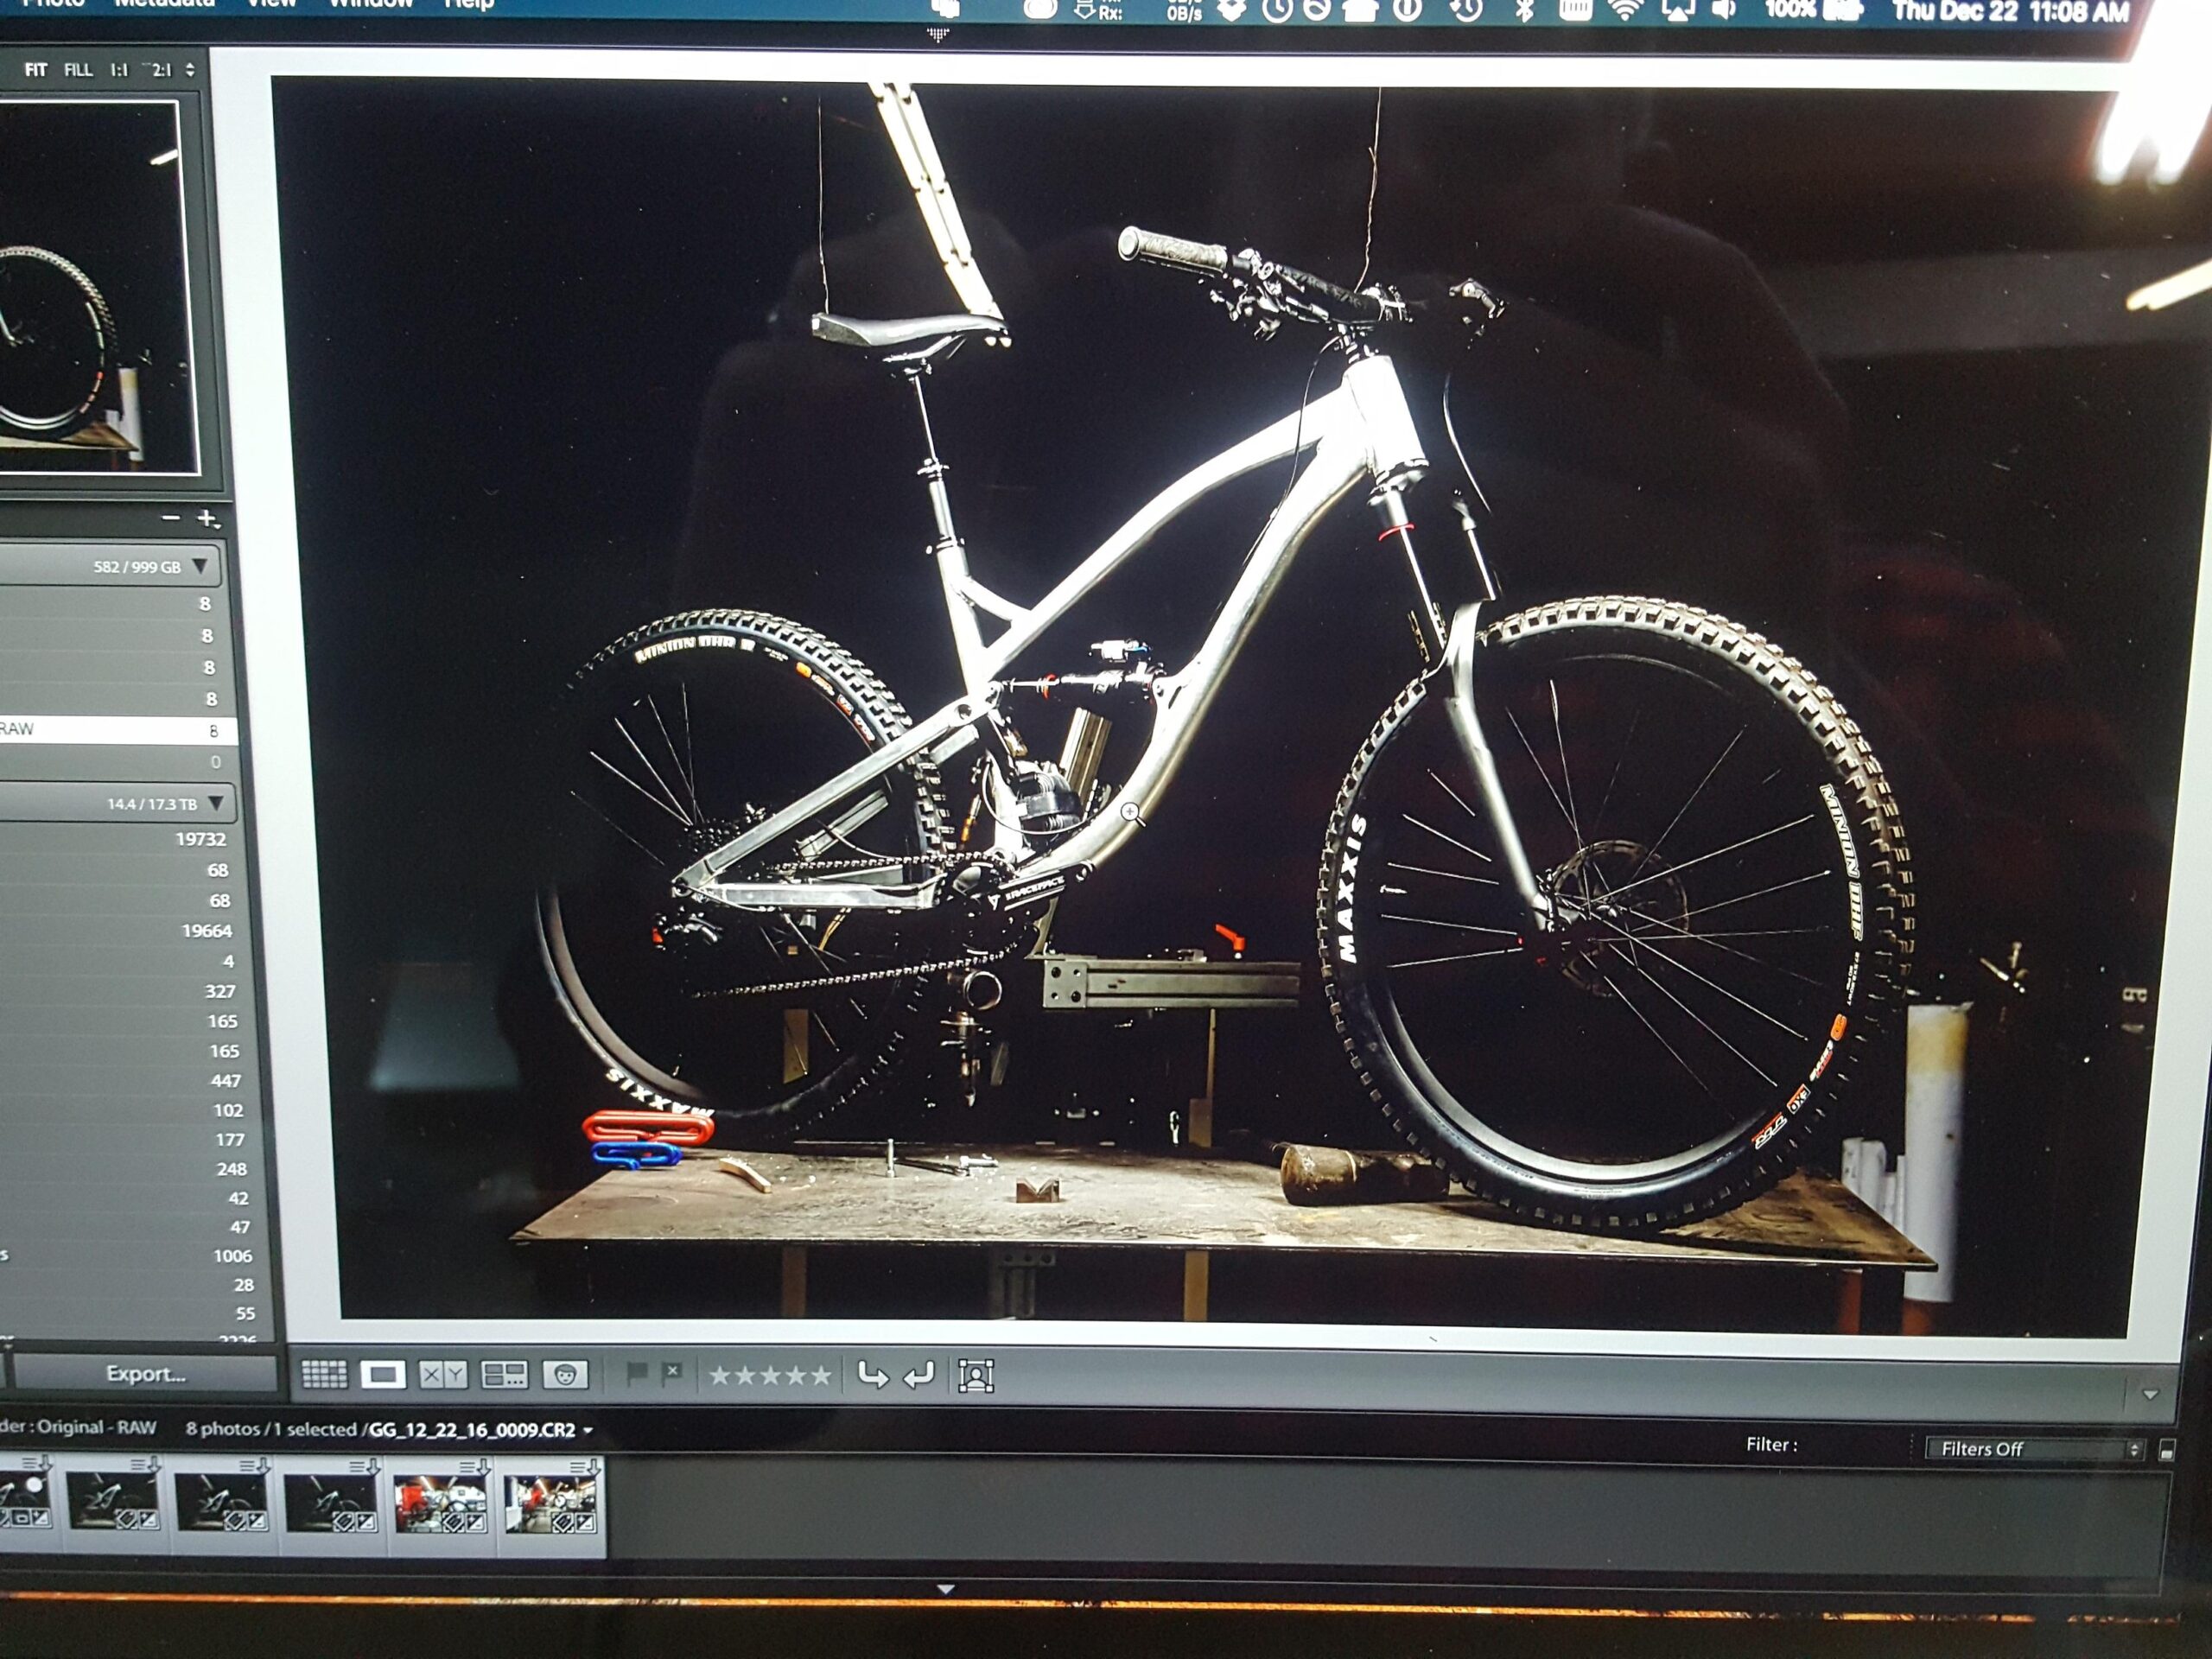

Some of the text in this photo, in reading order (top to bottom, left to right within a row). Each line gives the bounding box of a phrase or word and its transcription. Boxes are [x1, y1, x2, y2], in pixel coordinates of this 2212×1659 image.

[1098, 5, 1203, 23] Rx: 0B/s
[1765, 0, 2130, 22] 100% Thu Dec 22 11:08 AM
[24, 62, 48, 77] FIT
[65, 62, 93, 77] FILL
[93, 561, 119, 574] 582
[131, 561, 158, 574] 999
[161, 561, 181, 574] GB
[199, 596, 212, 611] 8
[200, 628, 213, 643] 8
[635, 637, 696, 664] MINION
[203, 660, 215, 675] 8
[206, 691, 218, 706] 8
[0, 721, 35, 735] RAW
[211, 755, 221, 769] 0
[107, 798, 136, 811] 14.4
[149, 798, 176, 811] 17.3
[179, 798, 198, 811] TB
[176, 832, 227, 847] 19732
[1819, 783, 1864, 941] MINION DHF
[207, 864, 229, 878] 68
[1337, 813, 1367, 964] MAXXIS
[210, 894, 231, 908] 68
[181, 924, 233, 938] 19664
[223, 955, 235, 969] 4
[205, 984, 236, 999] 327
[207, 1014, 238, 1029] 165
[210, 1044, 240, 1058] 165
[210, 1074, 242, 1088] 447
[606, 1068, 715, 1117] MAXXIS
[213, 1103, 244, 1118] 102
[216, 1133, 245, 1147] 177
[217, 1162, 248, 1176] 248
[228, 1192, 250, 1205] 42
[231, 1220, 251, 1234] 47
[214, 1249, 253, 1263] 1006
[234, 1279, 255, 1293] 28
[236, 1307, 257, 1321] 55
[106, 1366, 187, 1385] Export...
[37, 1420, 104, 1438] Original
[117, 1421, 157, 1434] RAW
[185, 1421, 199, 1435] 8
[200, 1421, 260, 1439] photos
[287, 1422, 358, 1437] selected
[1942, 1441, 2024, 1458] Filters Off
